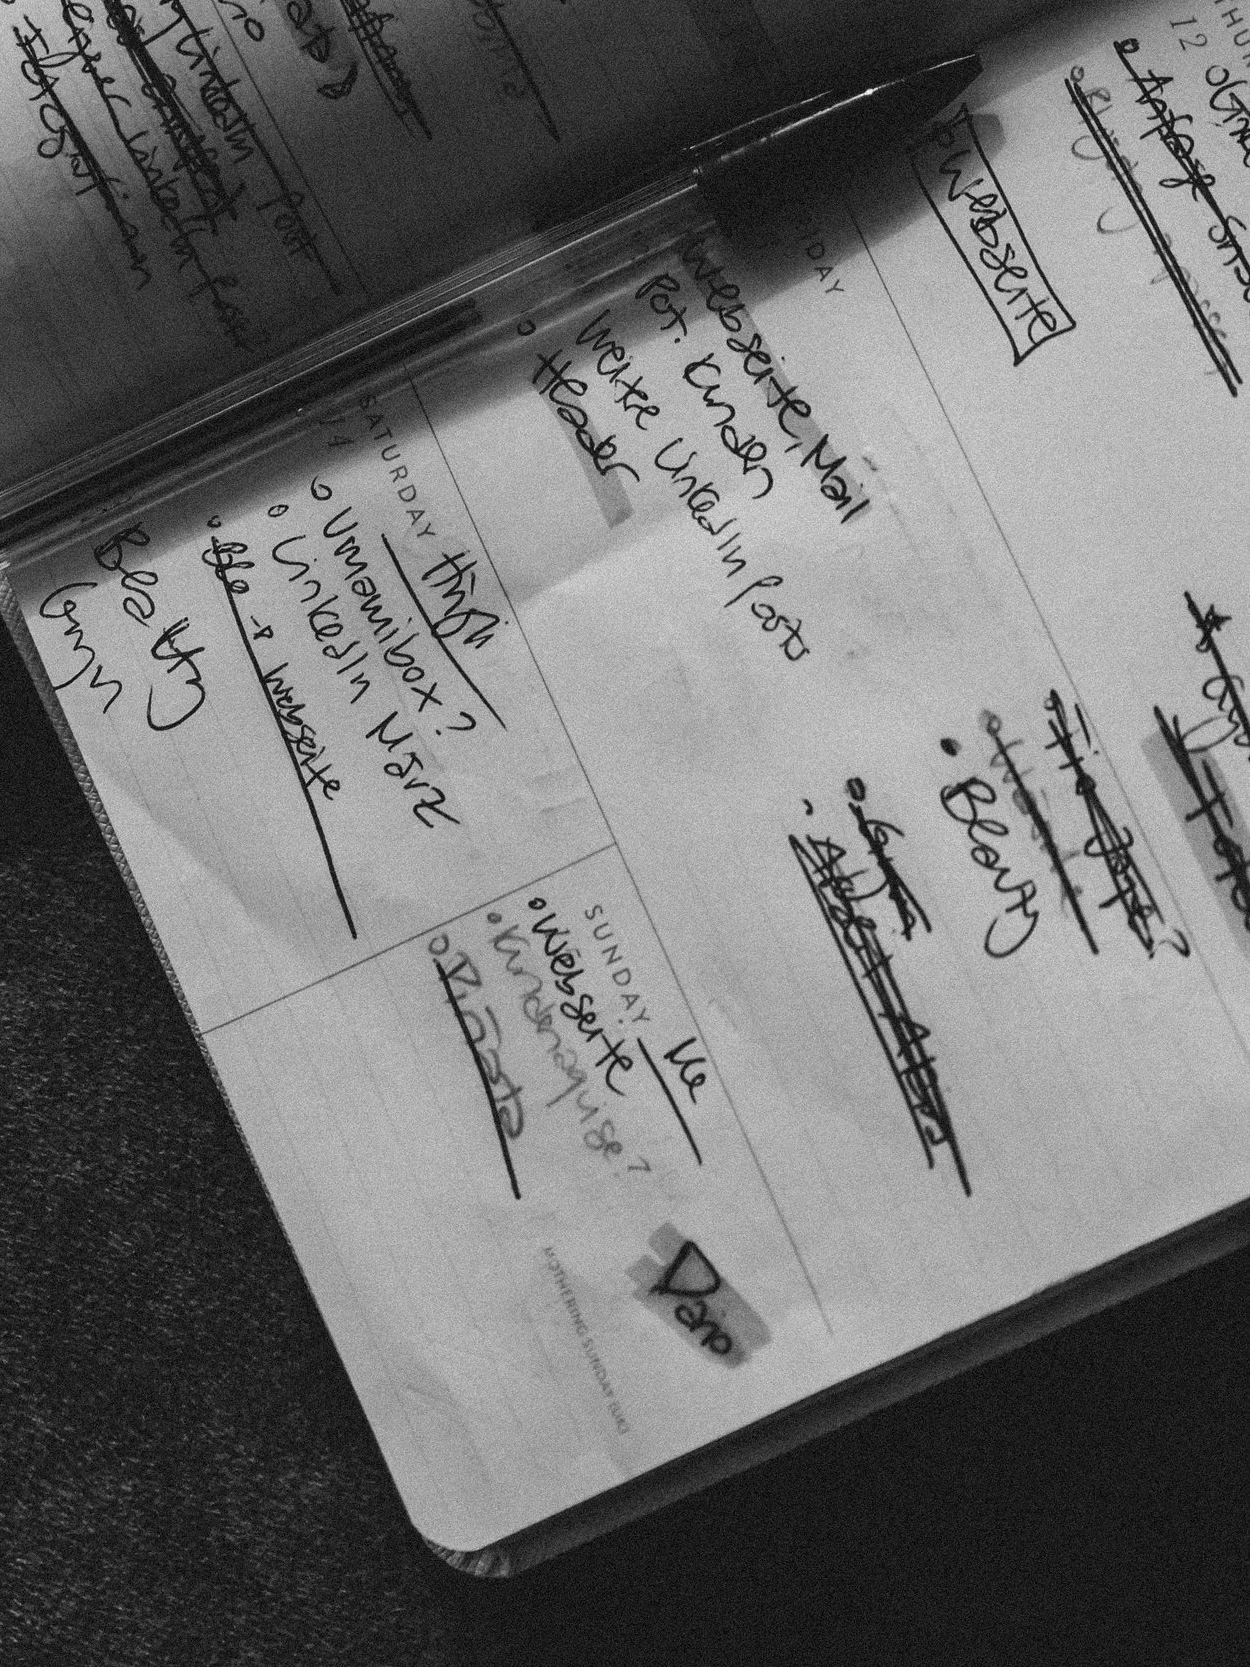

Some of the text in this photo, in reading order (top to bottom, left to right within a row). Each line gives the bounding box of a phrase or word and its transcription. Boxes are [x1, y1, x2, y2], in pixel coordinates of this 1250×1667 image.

[1170, 17, 1207, 51] 12
[359, 389, 436, 538] SATURDAY
[271, 535, 371, 704] LinkedIn
[584, 905, 650, 1022] SUNDAY
[540, 1242, 595, 1340] MOTHERING
[580, 1335, 618, 1403] SUNDAY
